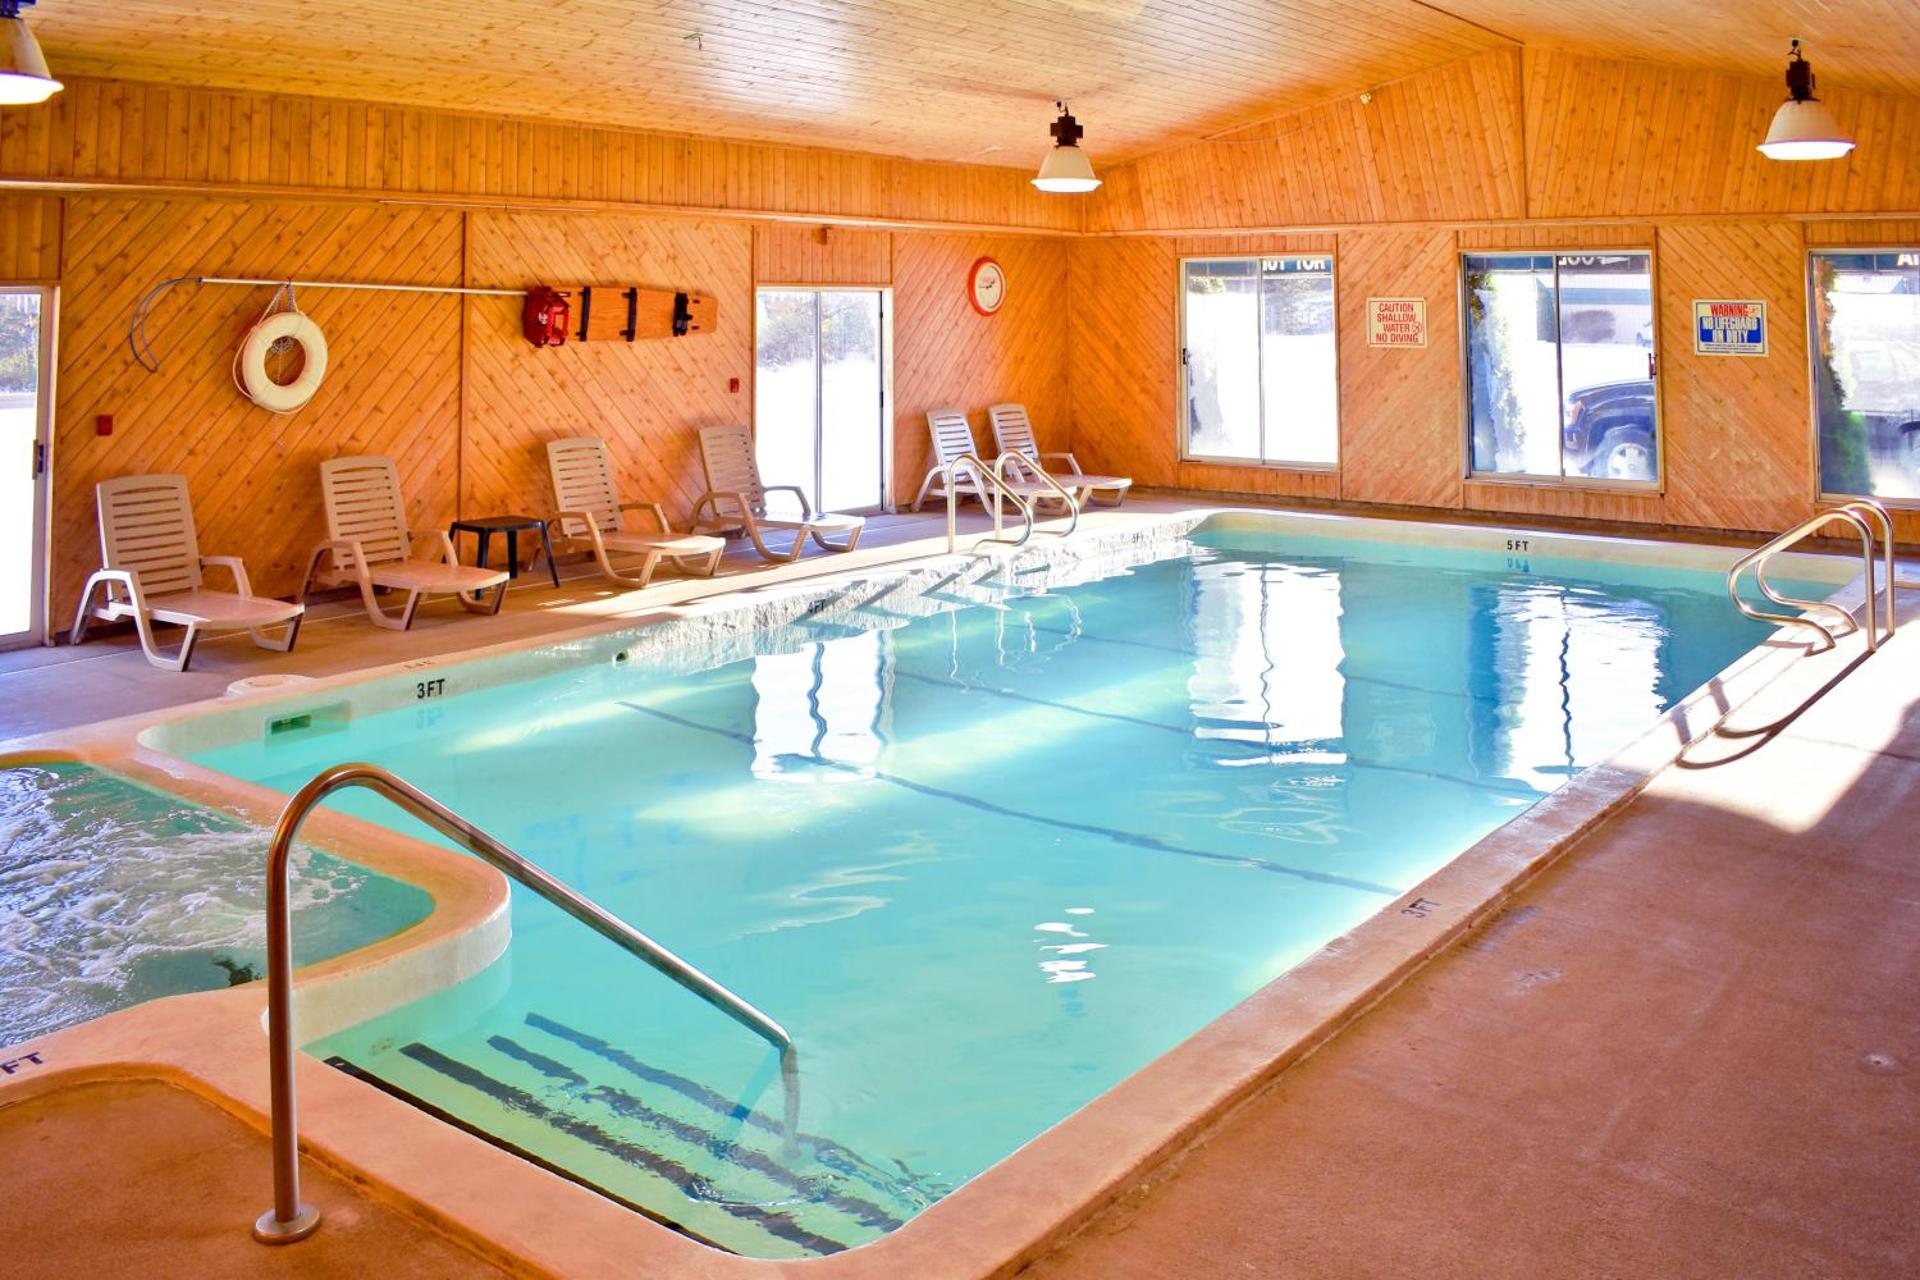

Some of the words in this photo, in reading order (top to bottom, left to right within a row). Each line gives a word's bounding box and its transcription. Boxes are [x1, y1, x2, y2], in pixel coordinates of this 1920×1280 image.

[1379, 303, 1414, 312] CAUTION
[1710, 303, 1748, 317] WARNING
[1376, 313, 1416, 322] SHALLOW
[1702, 317, 1713, 330] NO
[1715, 317, 1758, 330] LIFEGUARD
[1383, 323, 1410, 332] WATER
[1376, 333, 1388, 342] NO
[1390, 333, 1419, 342] DIVING
[1713, 330, 1724, 343] ON
[1726, 330, 1749, 343] DUTY
[417, 678, 446, 699] 3FT
[1400, 898, 1442, 919] 3FT
